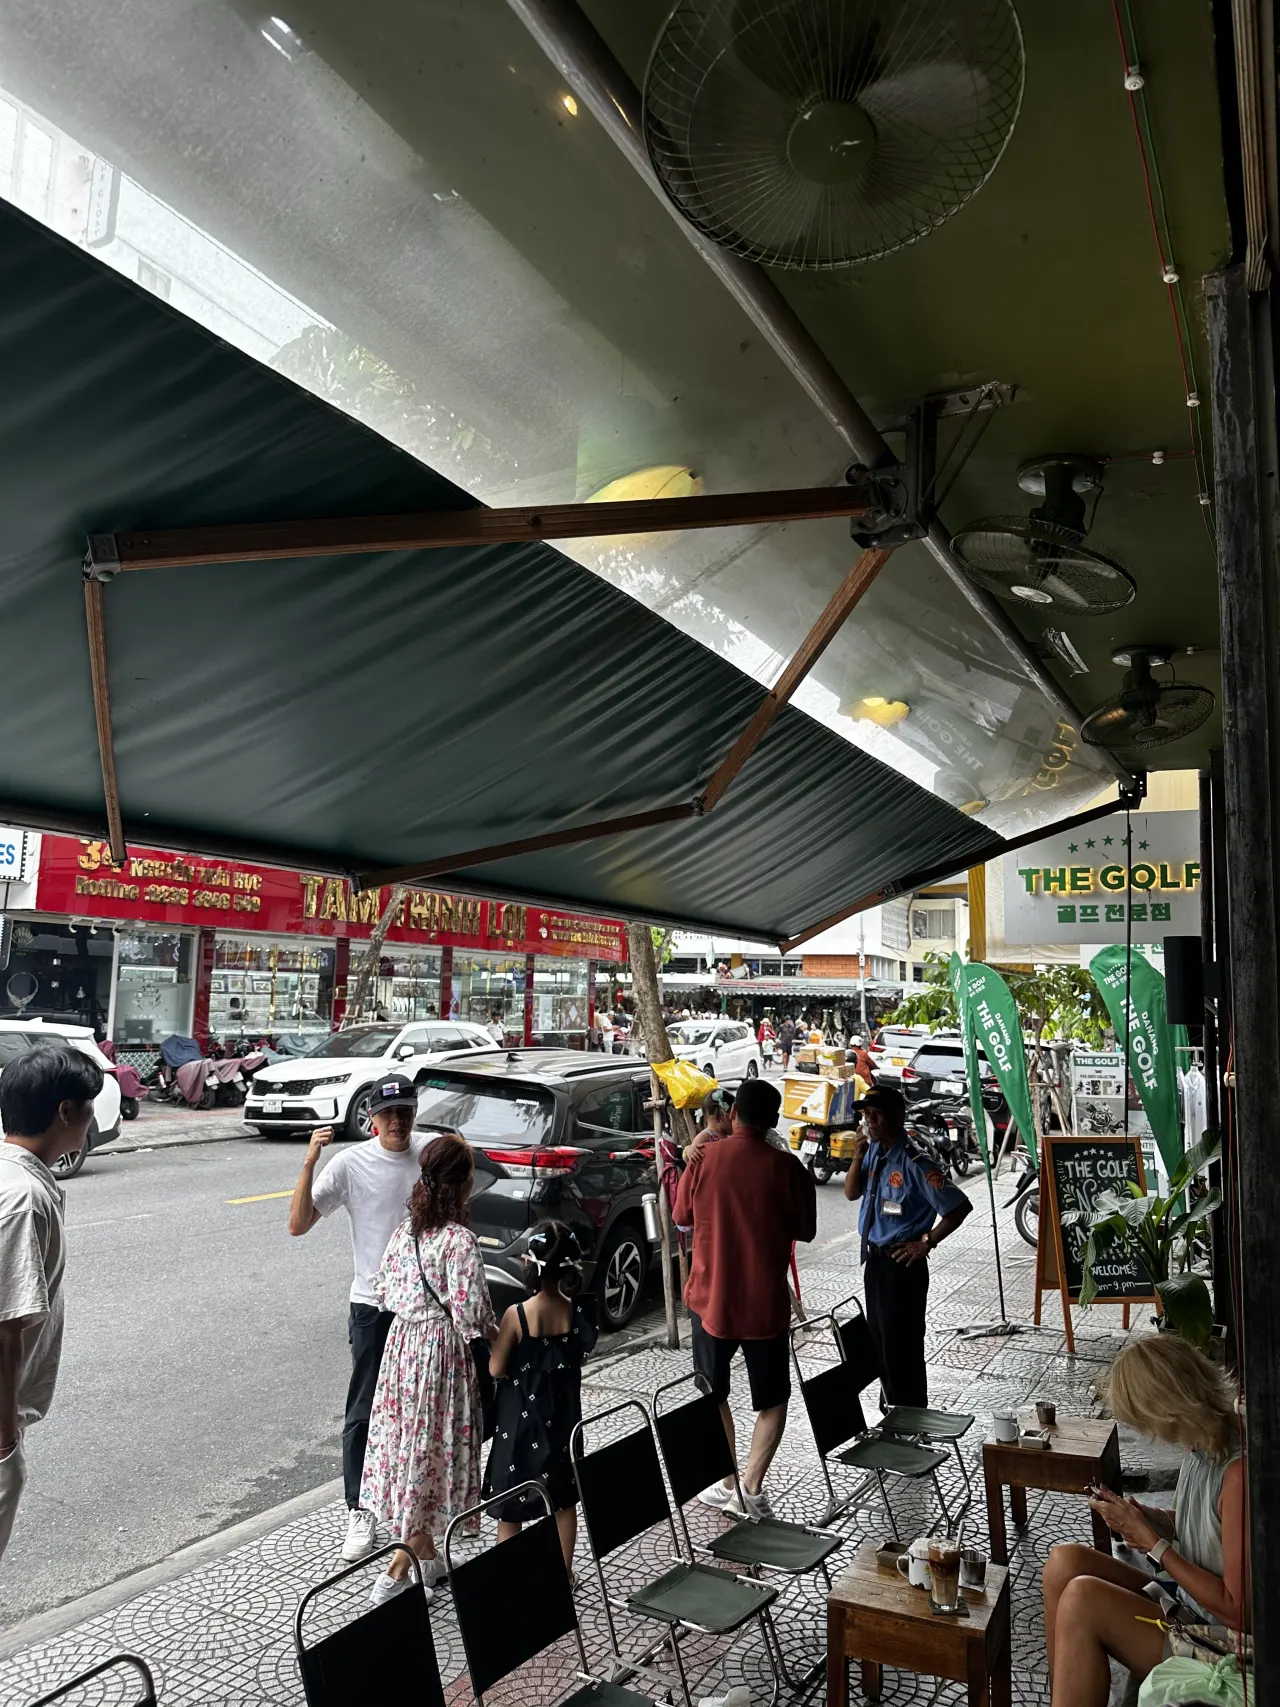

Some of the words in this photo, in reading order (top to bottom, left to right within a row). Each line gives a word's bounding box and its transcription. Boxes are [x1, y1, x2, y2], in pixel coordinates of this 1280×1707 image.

[75, 875, 139, 900] Hotline
[1018, 867, 1091, 892] THE
[1100, 863, 1200, 890] GOLF
[1057, 904, 1099, 923] 골프
[1103, 973, 1117, 985] THE
[976, 1000, 995, 1031] THE
[988, 1031, 1013, 1073] GOLF
[994, 1012, 1012, 1046] DANANG
[1141, 1011, 1159, 1056] DANANG
[1076, 1057, 1093, 1065] THE
[1095, 1057, 1118, 1066] GOLF
[1132, 1035, 1159, 1090] GOLF
[1065, 1161, 1094, 1179] THE
[1096, 1159, 1130, 1178] GOLF
[1091, 1264, 1133, 1276] WELCOME
